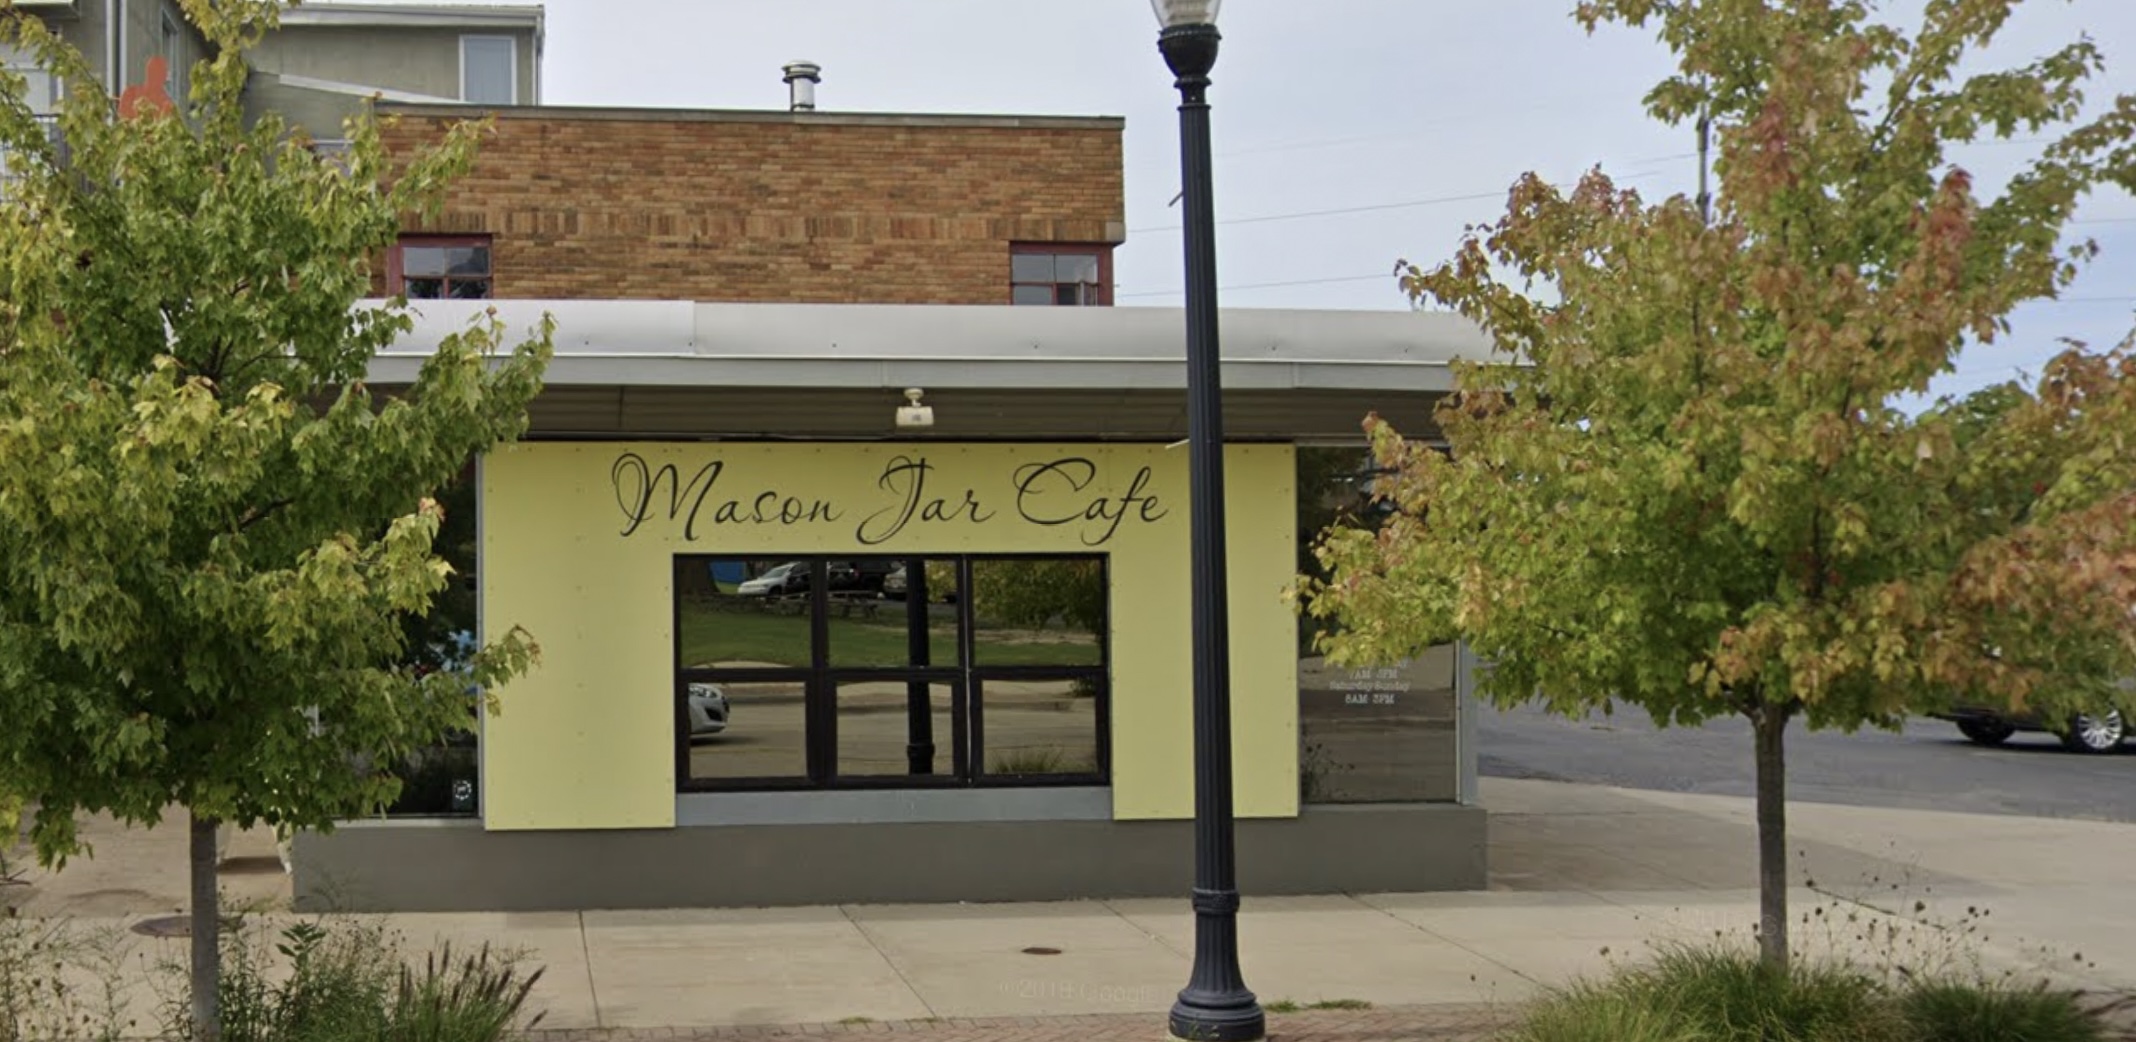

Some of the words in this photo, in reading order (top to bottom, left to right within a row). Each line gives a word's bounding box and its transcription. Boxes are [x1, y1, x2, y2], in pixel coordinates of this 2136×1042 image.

[611, 452, 843, 542] Mason
[856, 455, 996, 545] Jar
[1012, 457, 1168, 546] Cafe
